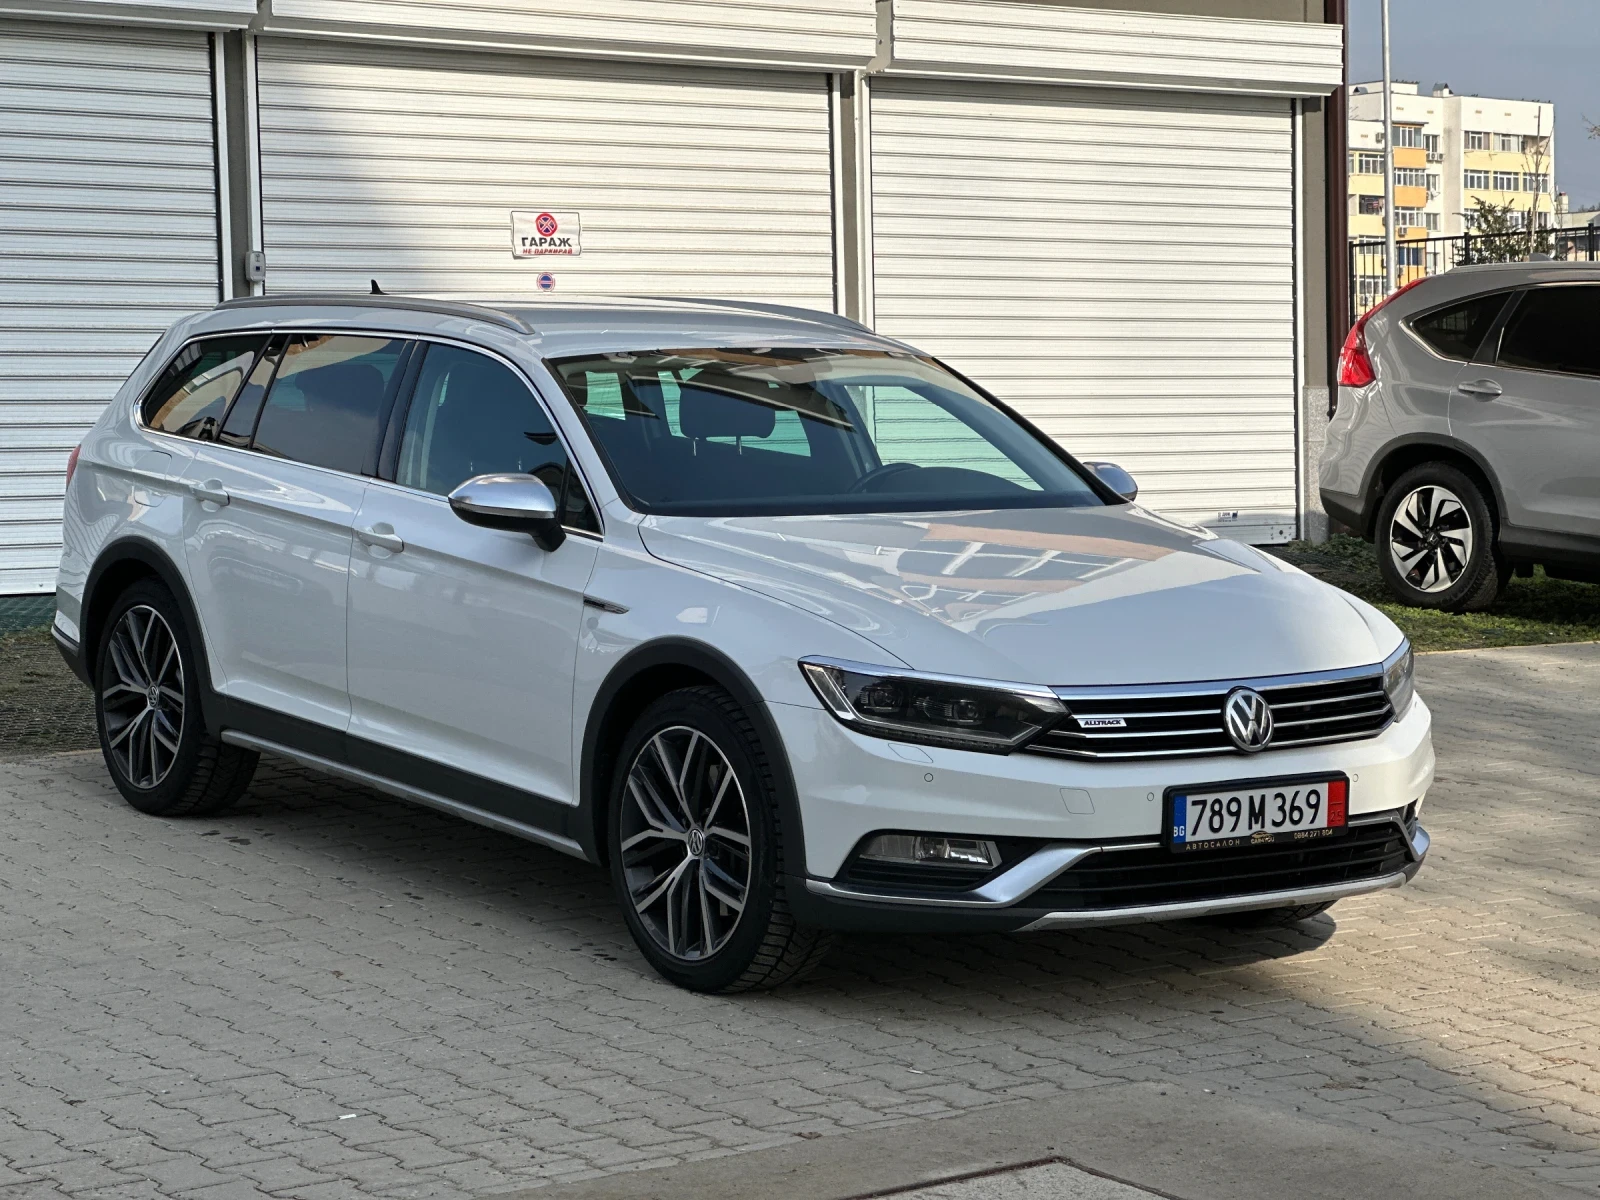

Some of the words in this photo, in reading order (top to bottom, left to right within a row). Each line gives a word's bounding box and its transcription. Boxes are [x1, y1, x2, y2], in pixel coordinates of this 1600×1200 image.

[521, 237, 572, 247] ГАРАЖ
[1083, 719, 1122, 727] ALLTRACK
[1173, 825, 1185, 838] BG
[1185, 838, 1240, 851] АВТОСАЛОН
